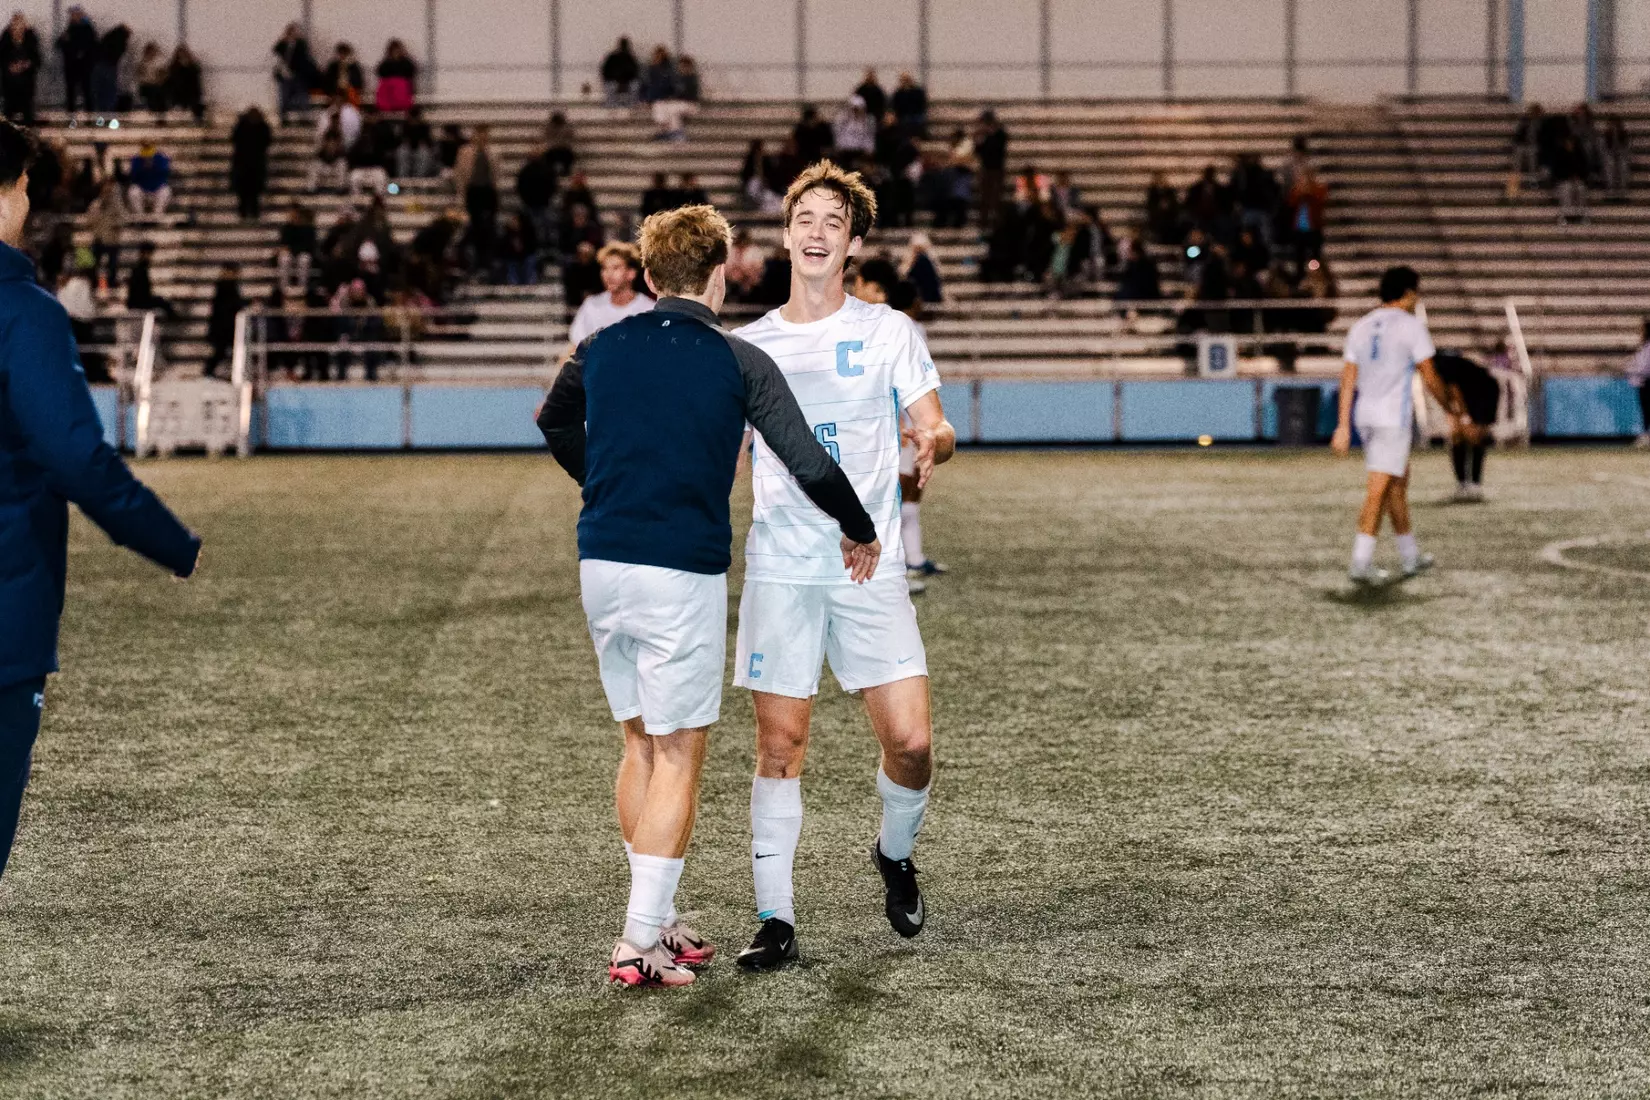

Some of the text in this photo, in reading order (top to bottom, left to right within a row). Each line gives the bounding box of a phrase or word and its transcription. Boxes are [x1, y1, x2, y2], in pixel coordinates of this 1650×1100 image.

[617, 333, 702, 346] NIKE
[836, 341, 864, 377] C
[814, 422, 840, 466] 6
[749, 652, 764, 678] C
